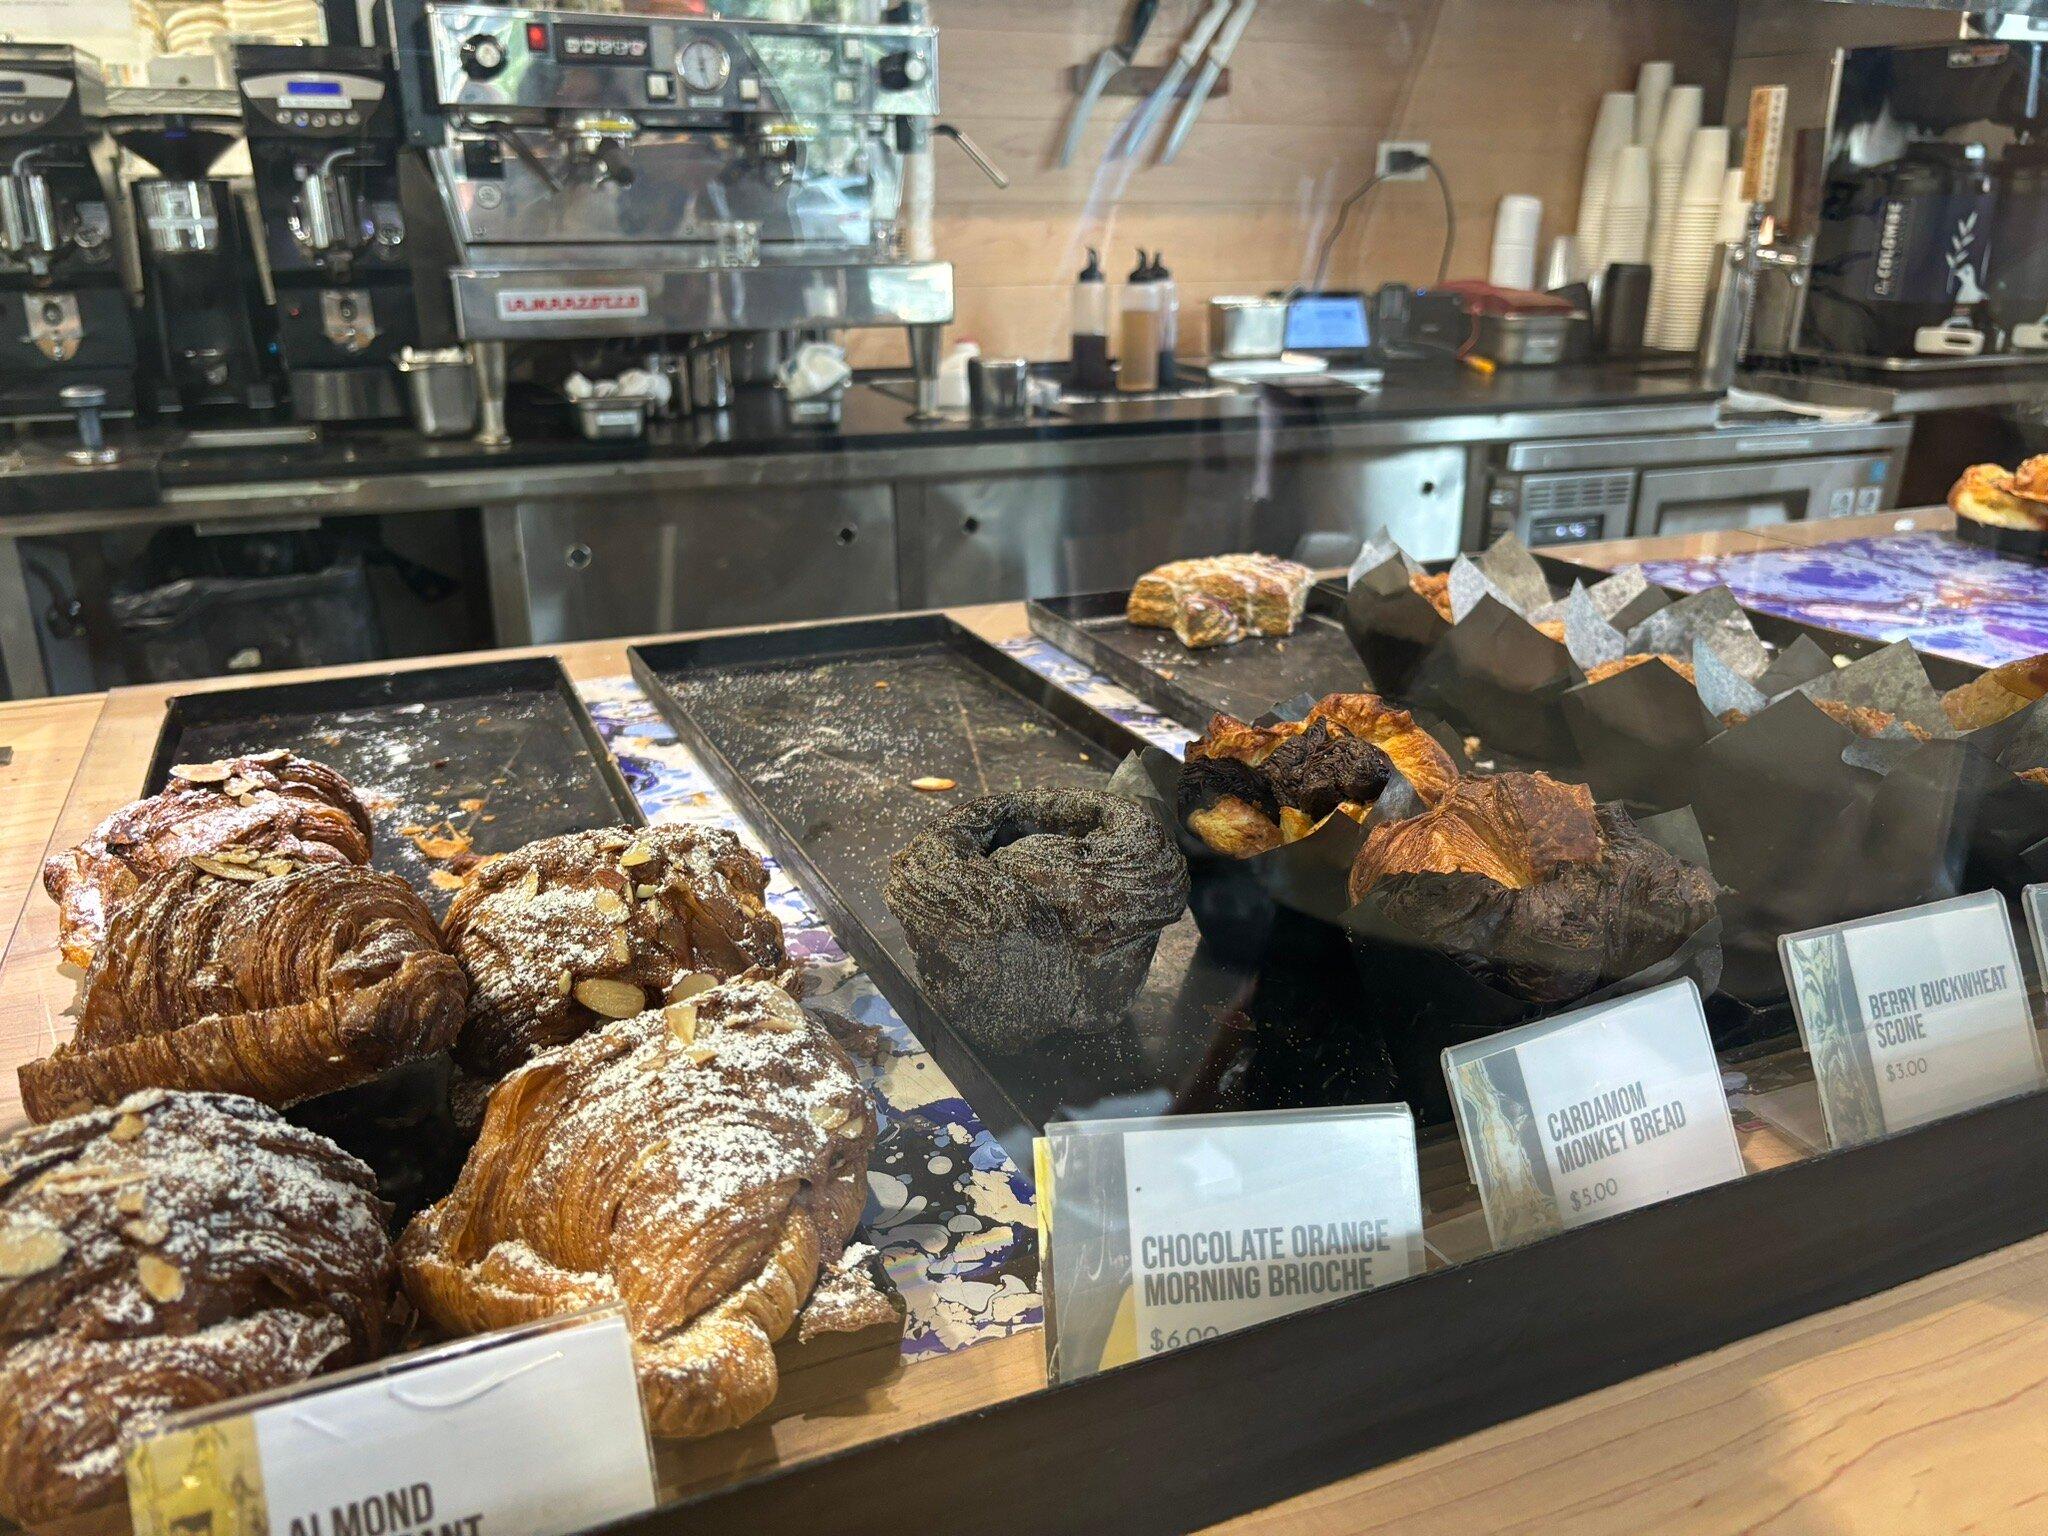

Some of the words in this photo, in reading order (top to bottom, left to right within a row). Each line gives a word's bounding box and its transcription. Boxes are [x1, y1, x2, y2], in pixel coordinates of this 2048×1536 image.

[1868, 985, 1918, 1020] BERRY
[1920, 965, 2008, 1008] BUCKWHEAT
[1875, 1013, 1926, 1049] SCONE
[1885, 1057, 1927, 1082] $3.00
[1547, 1081, 1647, 1142] CARDAMOM
[1555, 1121, 1628, 1174] MONKEY
[1630, 1100, 1687, 1145] BREAD
[1570, 1178, 1618, 1212] $5.00
[1141, 1227, 1286, 1269] CHOCOLATE
[1291, 1219, 1391, 1258] ORANGE
[1144, 1264, 1261, 1307] MORNING
[1268, 1257, 1375, 1298] BRIOCHE
[1150, 1326, 1219, 1352] $600
